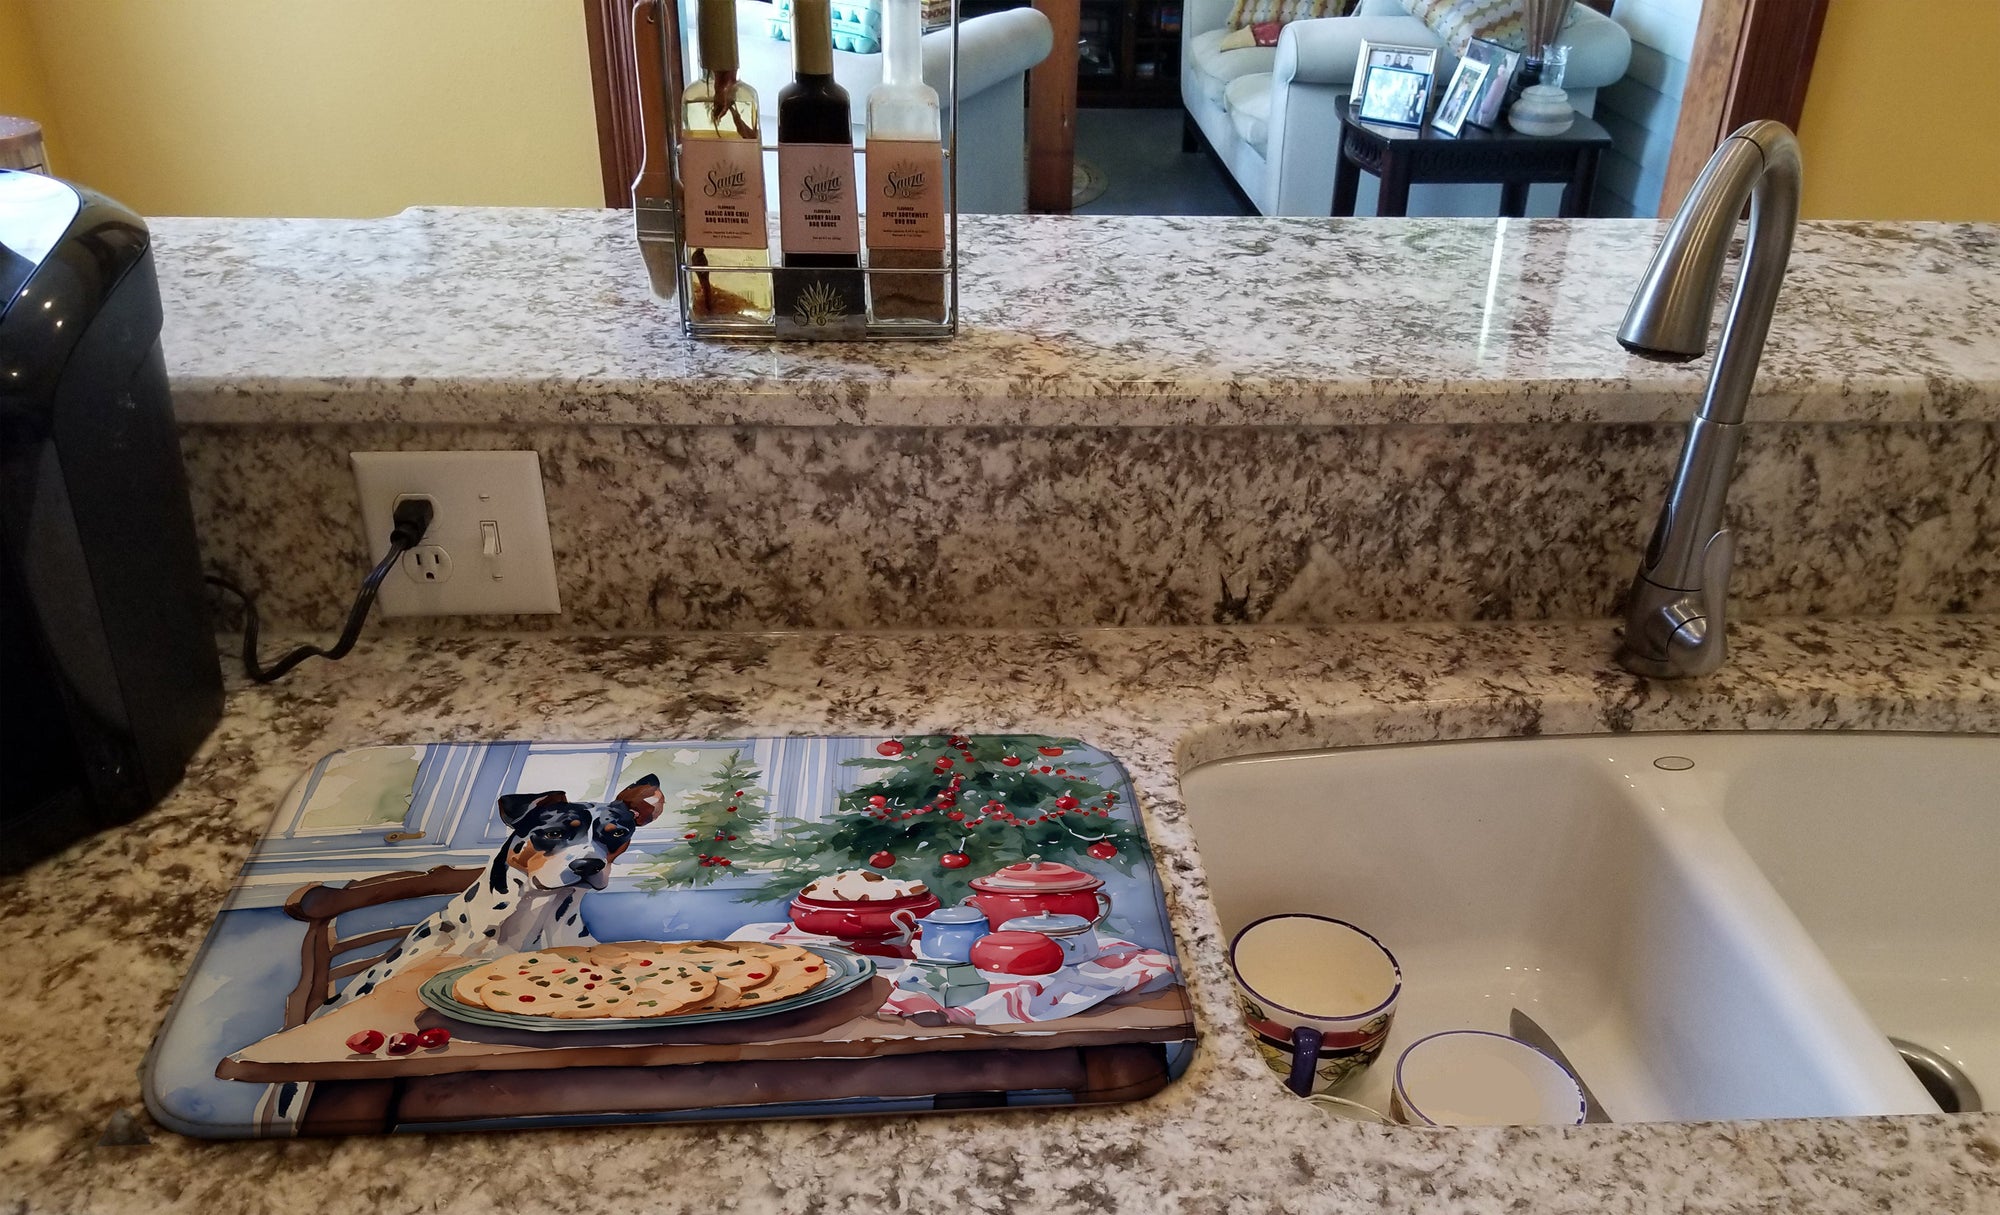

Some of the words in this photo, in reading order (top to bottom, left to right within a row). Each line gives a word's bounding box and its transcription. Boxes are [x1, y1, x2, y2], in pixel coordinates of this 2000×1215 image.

[704, 170, 746, 197] Sauza
[800, 175, 842, 202] Sauza
[883, 171, 926, 198] Sauza
[793, 296, 844, 327] Sauza
